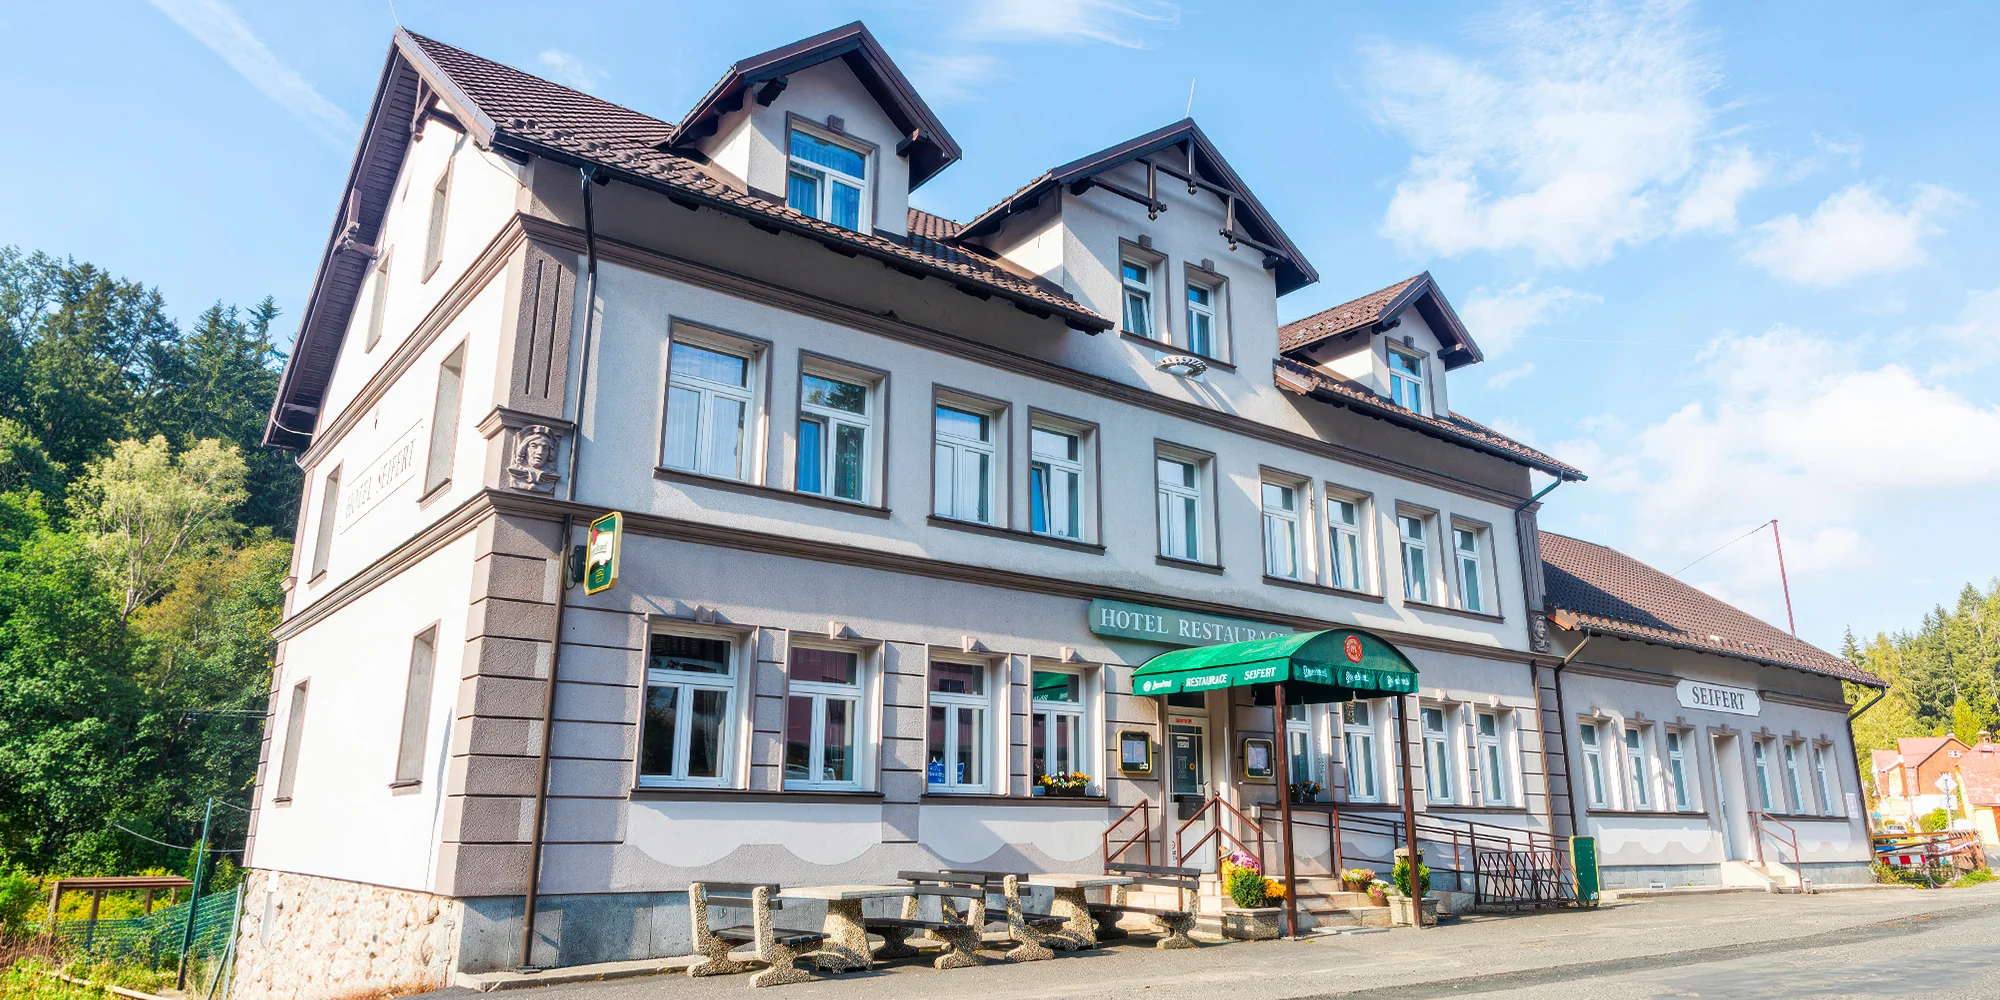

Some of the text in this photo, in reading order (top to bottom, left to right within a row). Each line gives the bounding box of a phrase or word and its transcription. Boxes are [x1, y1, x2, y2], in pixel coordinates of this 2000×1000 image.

[378, 438, 416, 489] SEIFERT
[1100, 607, 1288, 643] HOTEL RESTAURA
[1185, 673, 1228, 688] RESTAURACE
[1243, 666, 1277, 680] SEIFERT
[1691, 685, 1745, 710] SEIFERT
